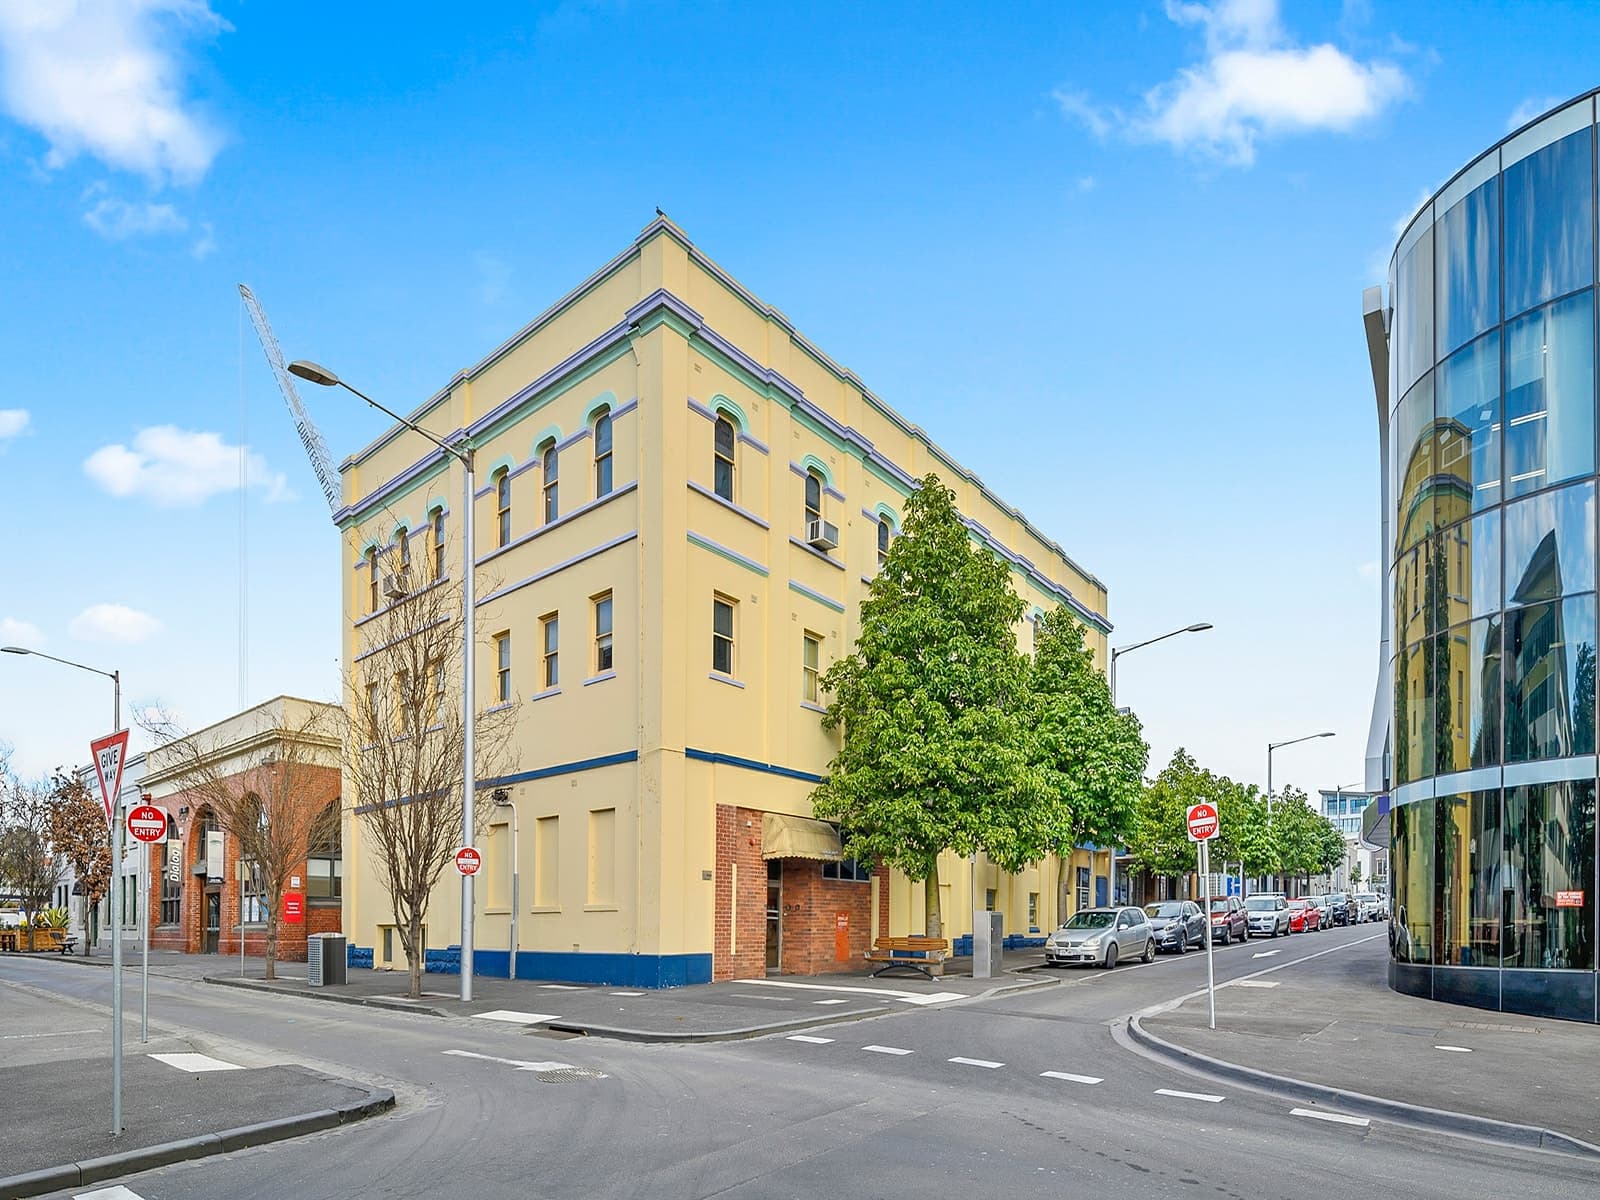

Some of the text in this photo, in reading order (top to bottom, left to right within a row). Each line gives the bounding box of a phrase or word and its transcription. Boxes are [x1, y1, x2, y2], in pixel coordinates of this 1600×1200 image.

[101, 749, 118, 768] GIVE
[104, 768, 117, 782] WAY
[141, 811, 154, 819] NO
[1197, 809, 1207, 818] NO
[134, 828, 161, 837] ENTRY
[1193, 825, 1214, 835] ENTRY
